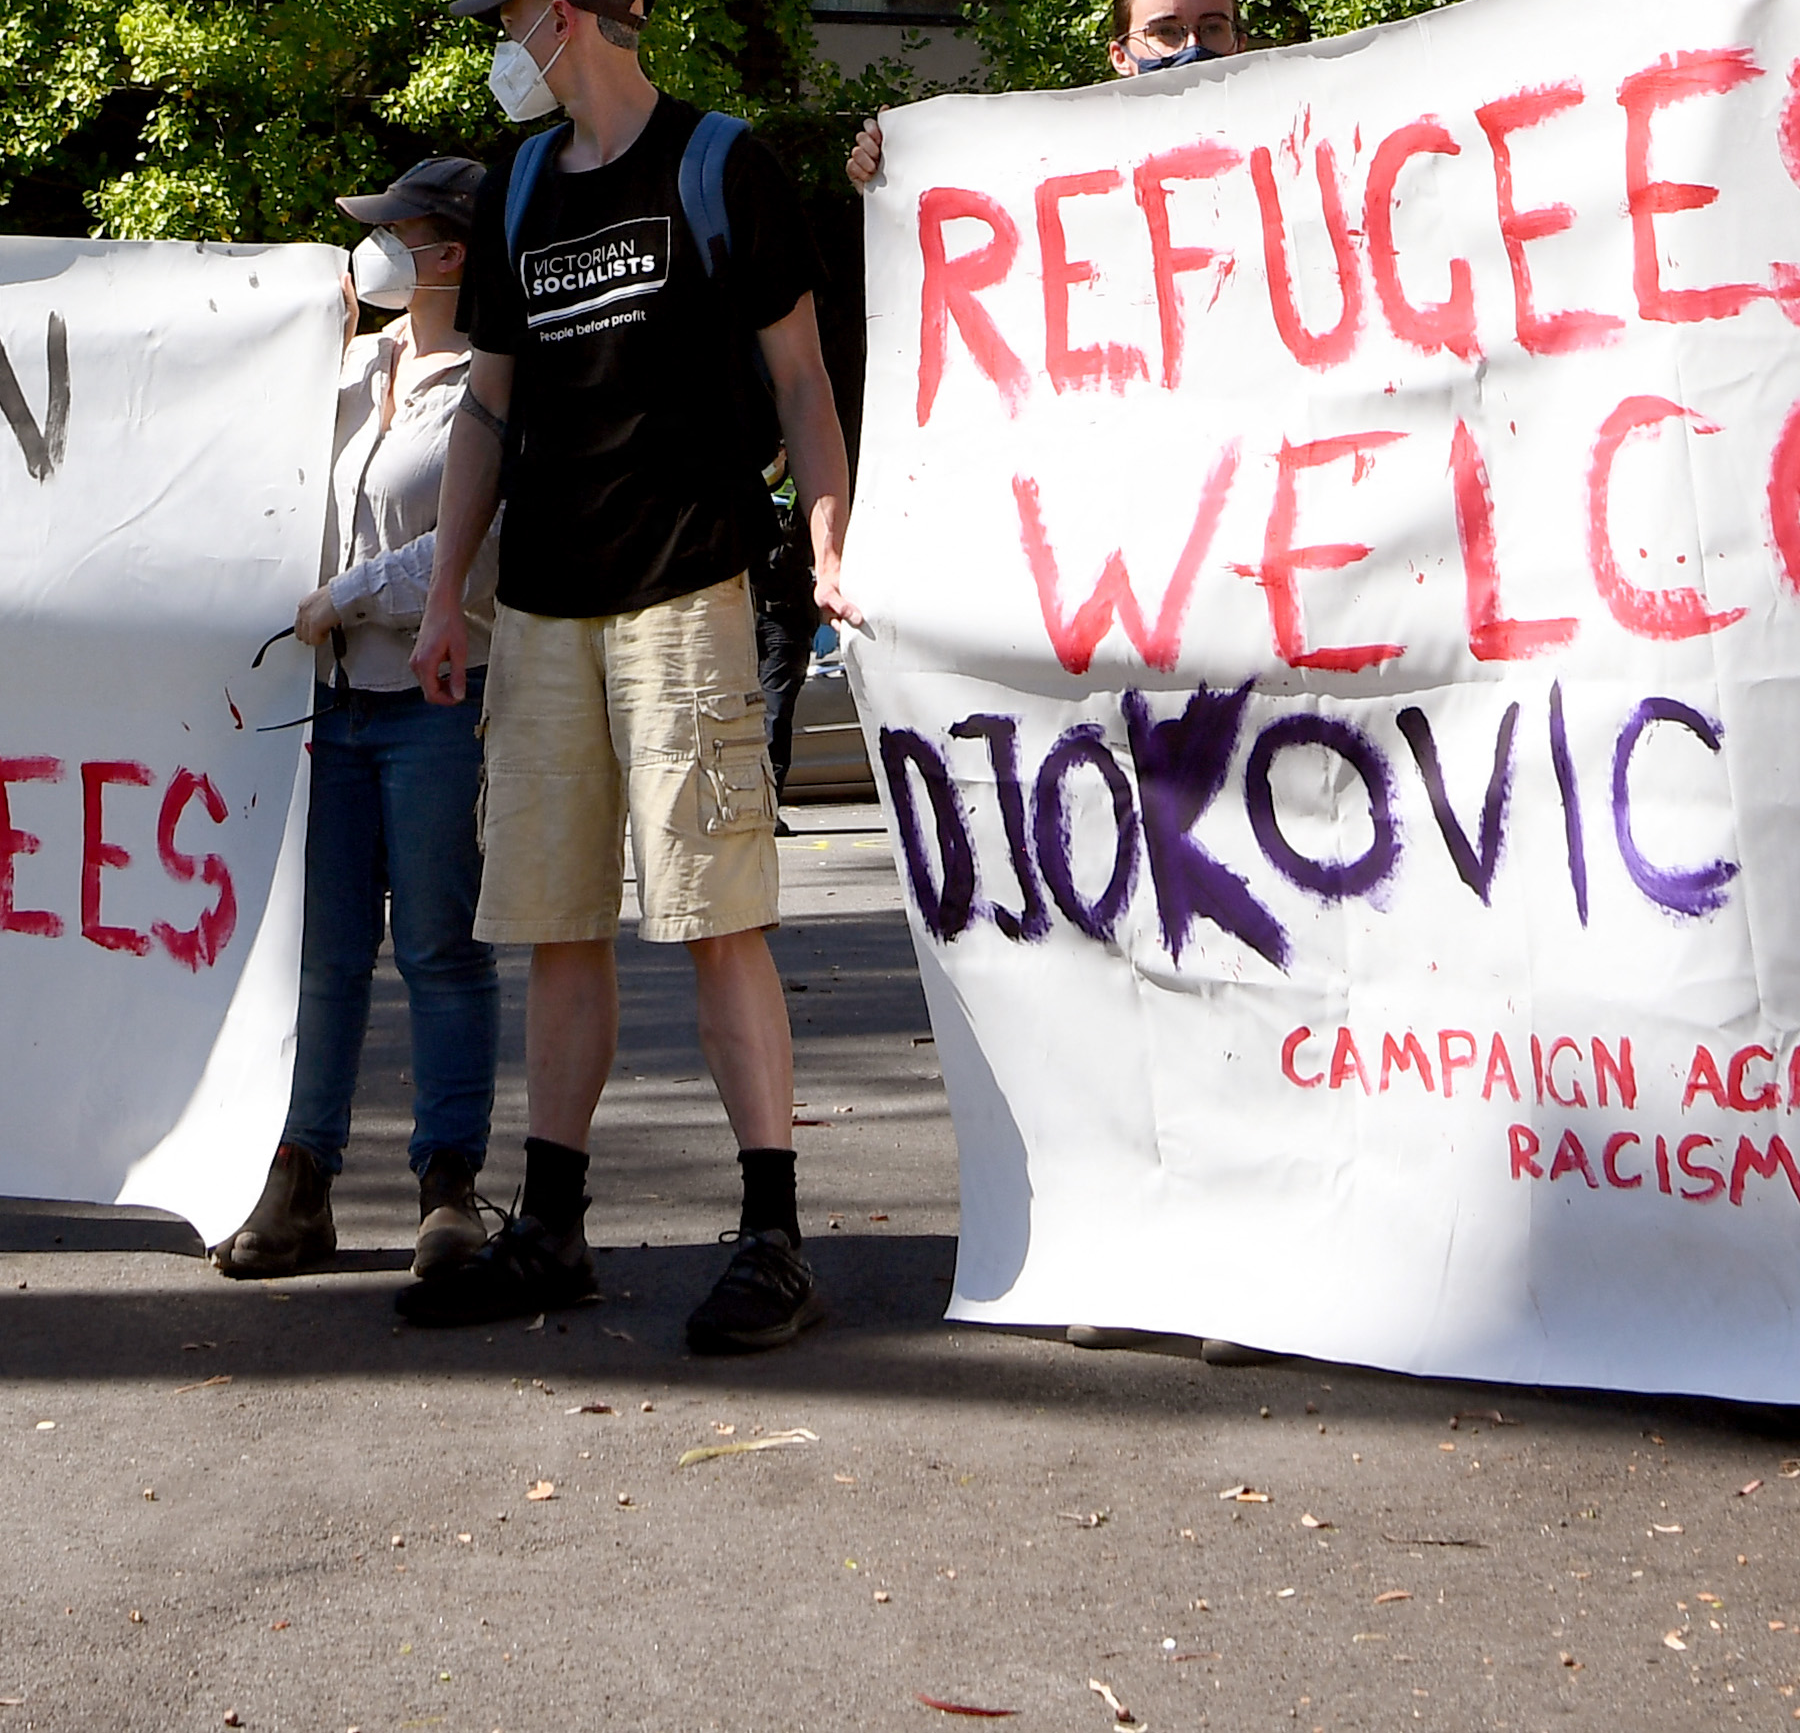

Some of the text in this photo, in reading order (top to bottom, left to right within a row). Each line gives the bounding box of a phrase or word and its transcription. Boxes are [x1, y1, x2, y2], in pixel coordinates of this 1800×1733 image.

[533, 254, 655, 296] SOCIALISTS
[534, 239, 635, 277] VICTORIAN
[540, 310, 647, 343] People before profit
[876, 676, 1739, 972] DJOKOVIC
[1280, 1026, 1637, 1116] CAMPAIGN
